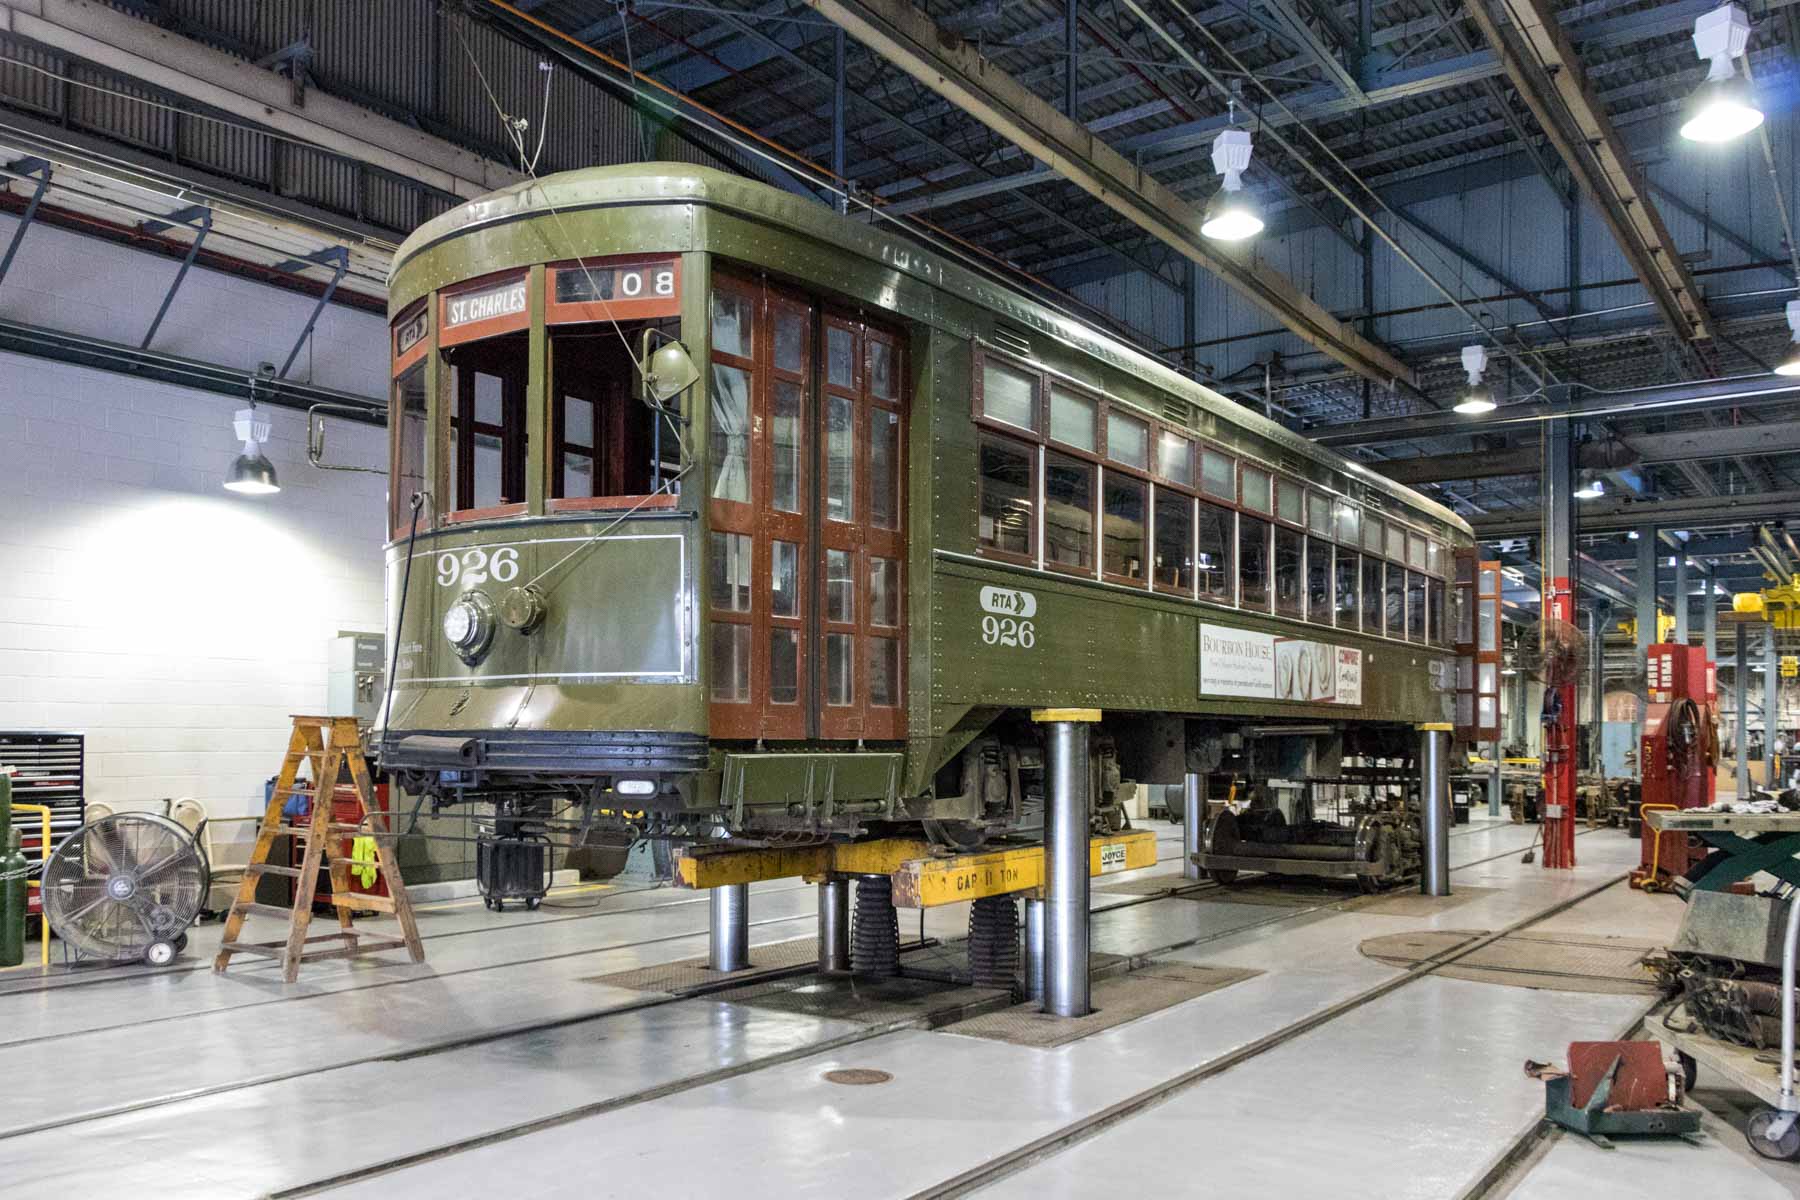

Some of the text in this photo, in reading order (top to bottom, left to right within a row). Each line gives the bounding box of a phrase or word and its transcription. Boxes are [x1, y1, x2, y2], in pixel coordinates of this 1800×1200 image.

[451, 286, 526, 324] ST. CHARLES
[437, 547, 520, 587] 926
[992, 592, 1012, 609] RTA
[982, 615, 1035, 649] 926
[1102, 850, 1125, 860] JOYCE
[1000, 868, 1019, 883] TON
